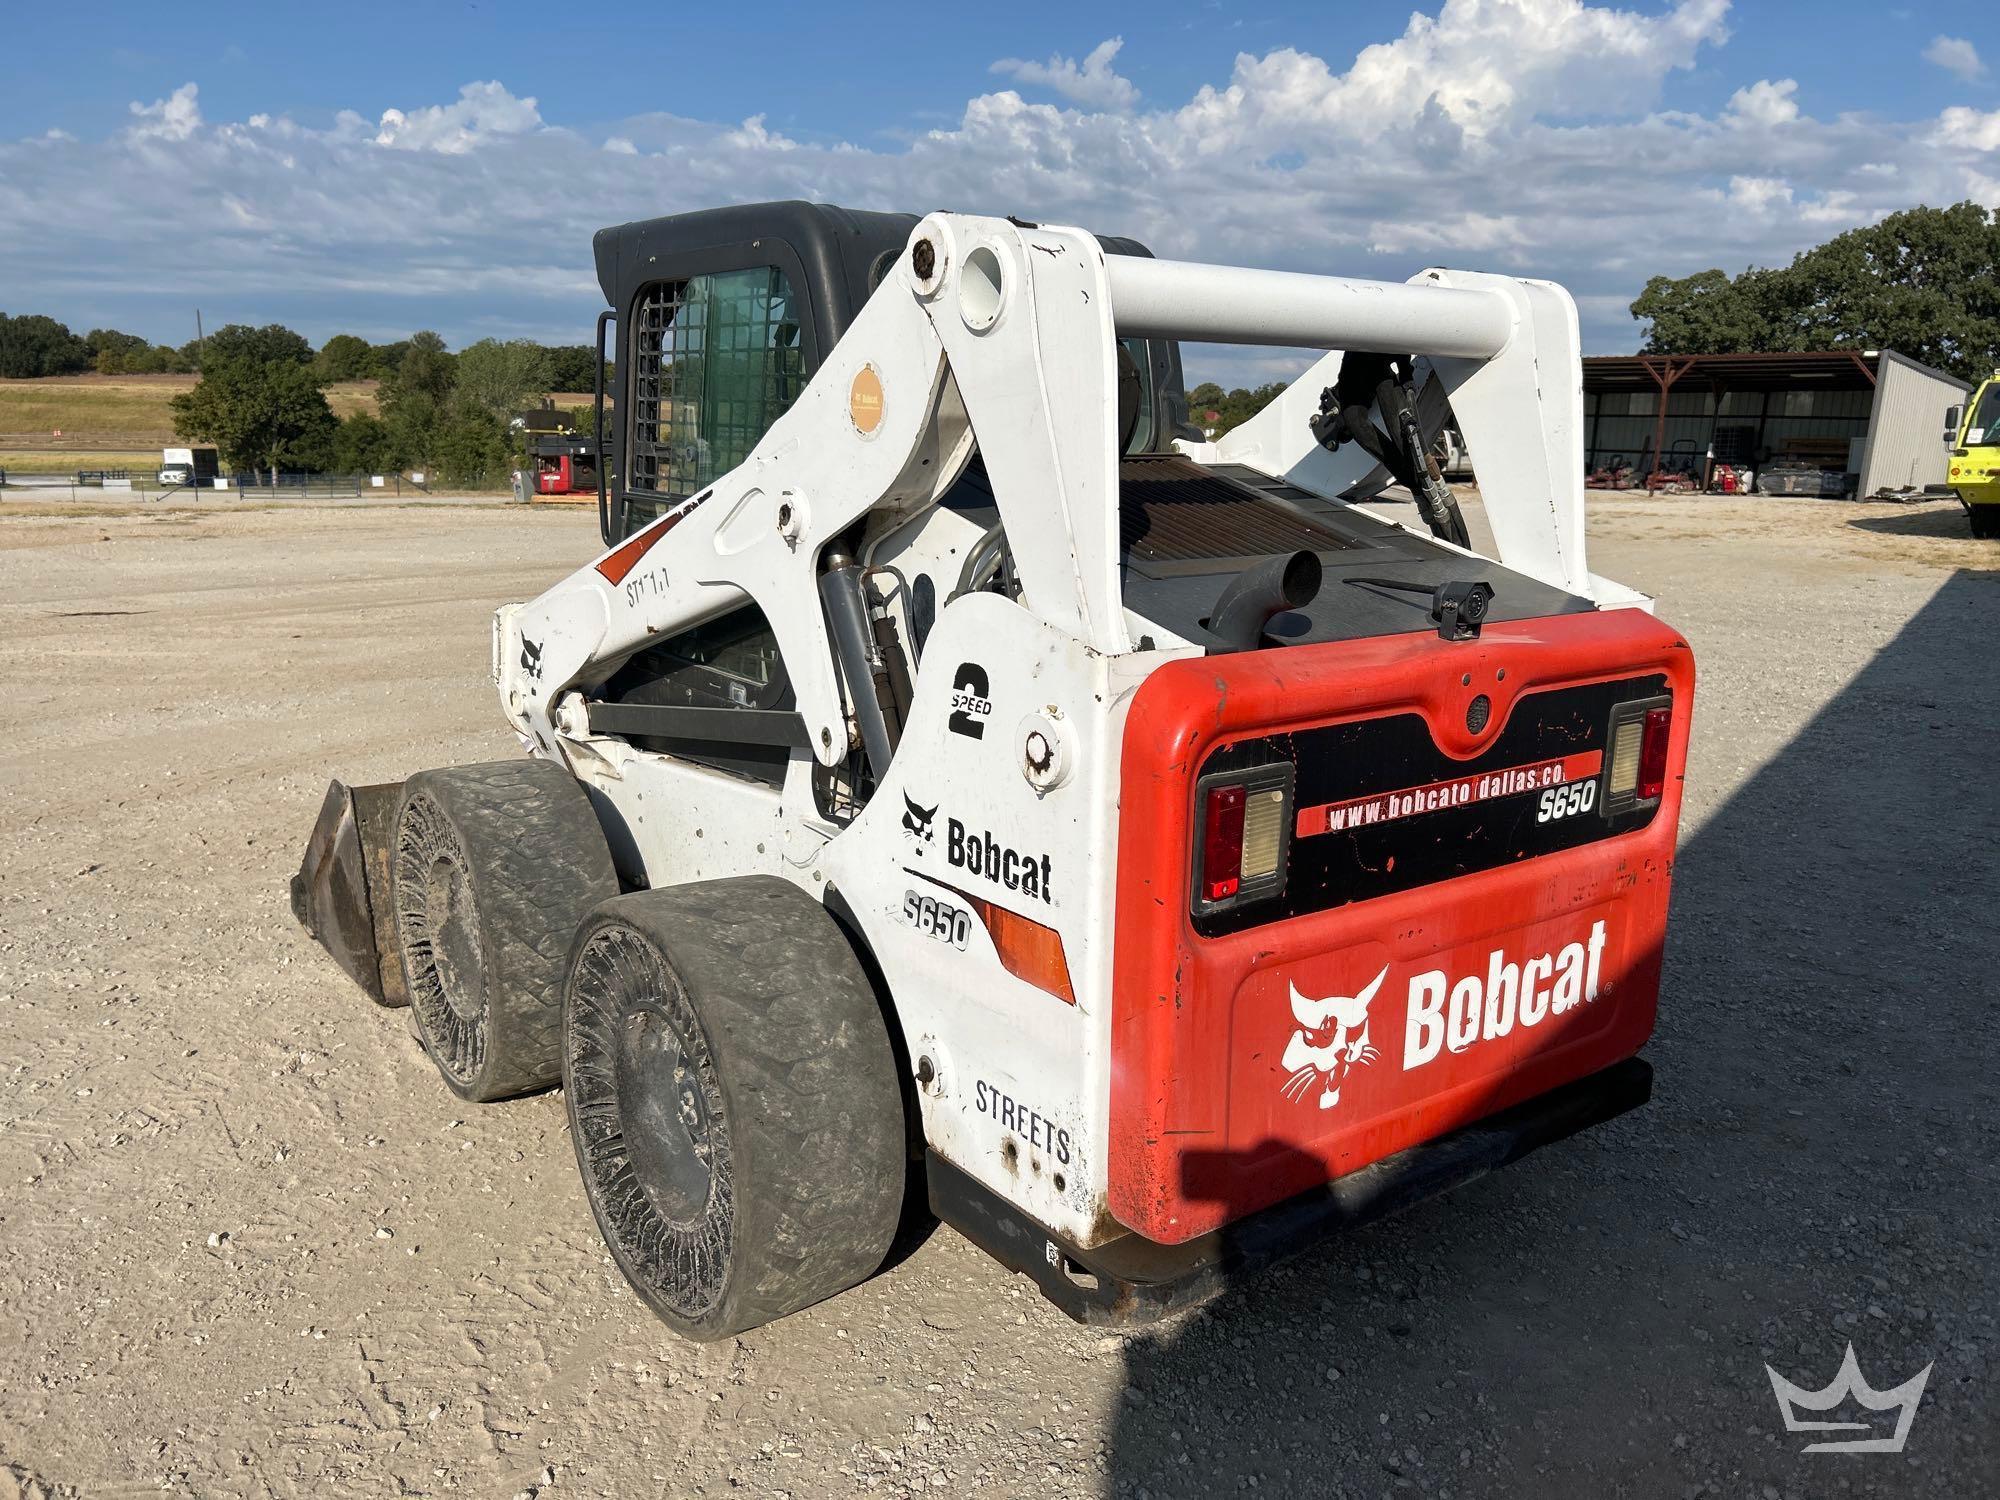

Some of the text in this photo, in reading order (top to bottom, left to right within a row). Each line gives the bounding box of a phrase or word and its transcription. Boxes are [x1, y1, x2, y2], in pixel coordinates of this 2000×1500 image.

[949, 662, 989, 740] 2
[951, 694, 992, 716] SPEED
[1329, 763, 1566, 831] www.bobcatodallas.co
[1537, 779, 1597, 823] S650
[948, 816, 1051, 905] Bobcat
[902, 889, 972, 952] S650
[1402, 919, 1606, 1071] Bobcat
[976, 1079, 1070, 1165] STREETS
